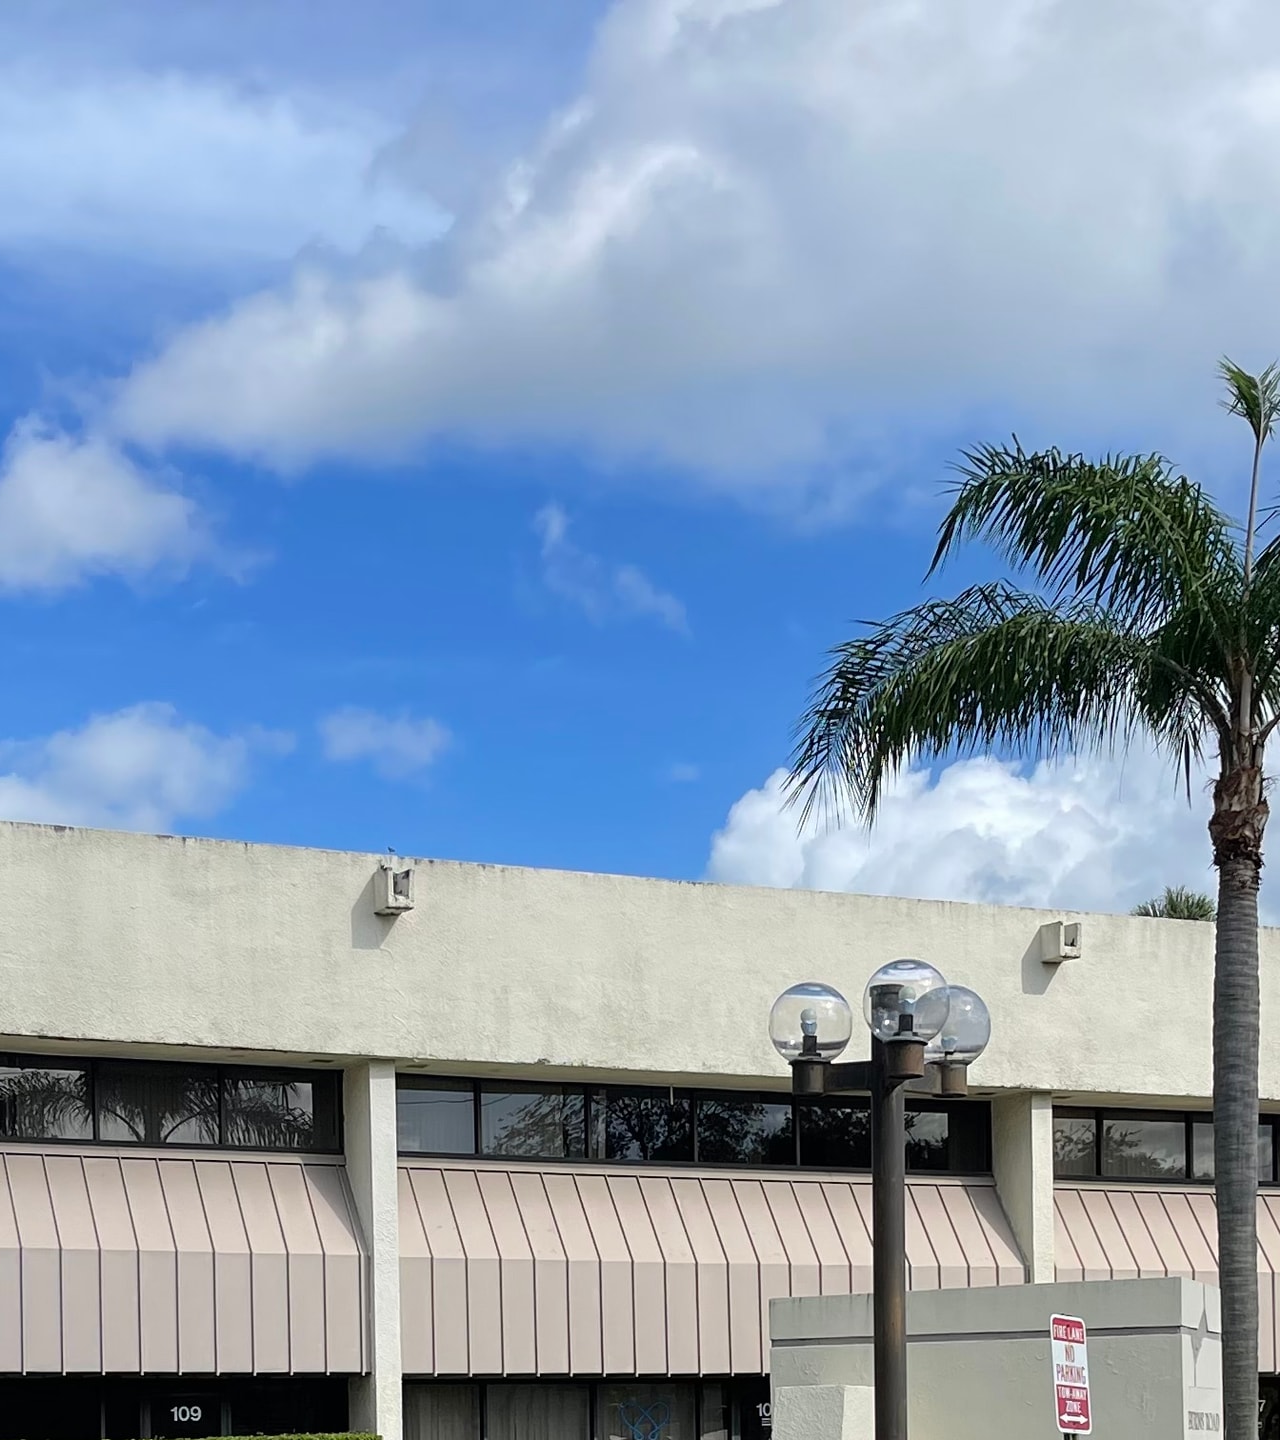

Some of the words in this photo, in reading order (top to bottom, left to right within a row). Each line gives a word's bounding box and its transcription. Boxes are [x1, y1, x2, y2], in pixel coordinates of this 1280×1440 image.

[1053, 1324, 1066, 1339] FIRE
[1067, 1326, 1084, 1341] LANE
[1064, 1344, 1075, 1363] NO
[1056, 1364, 1086, 1385] PARKING
[170, 1405, 202, 1422] 109
[755, 1402, 771, 1417] 10
[1065, 1401, 1081, 1413] ZONE
